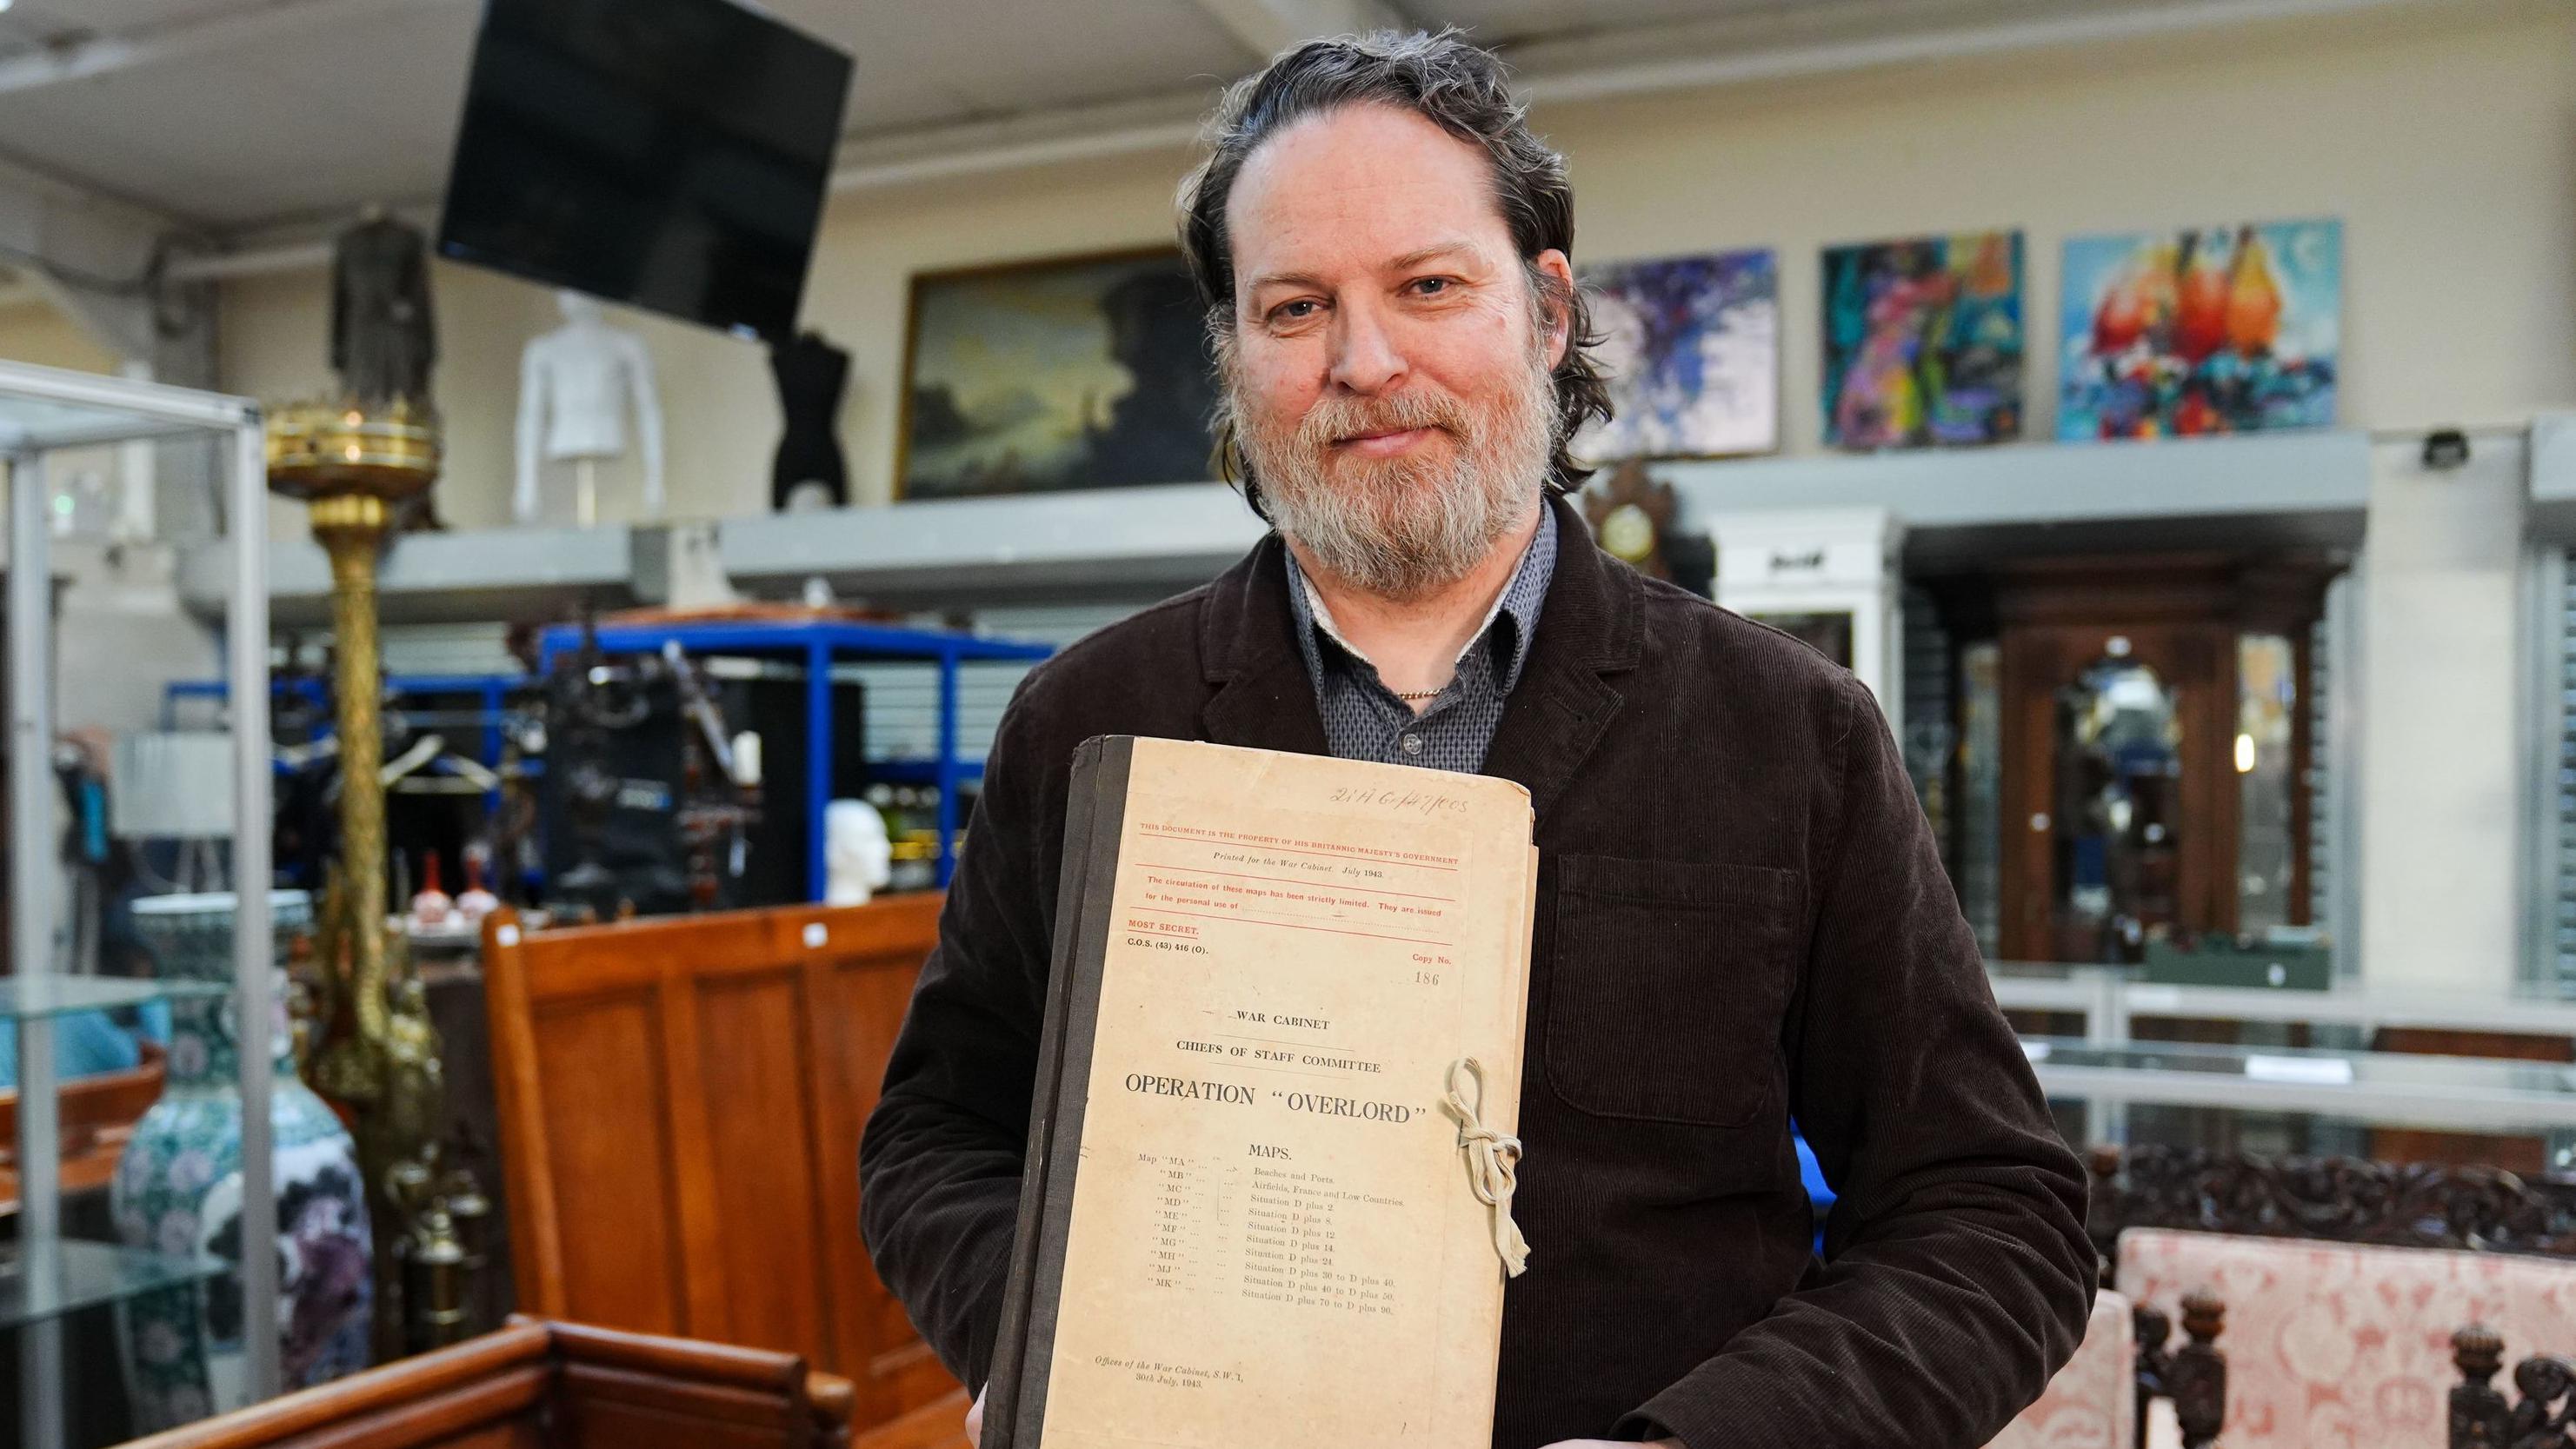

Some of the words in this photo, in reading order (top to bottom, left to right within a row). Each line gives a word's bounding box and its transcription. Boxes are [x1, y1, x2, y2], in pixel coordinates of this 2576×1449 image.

[1162, 826, 1206, 835] DOCUMENT
[1238, 834, 1280, 843] PROPERTY
[1311, 842, 1355, 853] BRITANNIC
[1358, 847, 1401, 858] MAJESTY'S
[1402, 853, 1459, 865] GOVERNMENT
[1214, 852, 1244, 861] Printed
[1342, 867, 1361, 877] July
[1166, 880, 1208, 889] circulation
[1223, 885, 1242, 894] these
[1246, 888, 1267, 897] maps
[1308, 895, 1336, 905] strictly
[1340, 898, 1369, 908] limited.
[1378, 902, 1398, 913] They
[1418, 907, 1441, 916] issued
[1177, 896, 1210, 907] personal
[1128, 920, 1155, 929] MOST
[1159, 923, 1199, 935] SECRET.
[1128, 938, 1153, 947] C.O.S.
[1155, 941, 1172, 951] (43)
[1413, 953, 1433, 963] Copy
[1438, 956, 1452, 965] No.
[1415, 971, 1440, 986] 186
[1235, 1009, 1266, 1023] WAR
[1273, 1014, 1330, 1030] CABINET
[1176, 1040, 1222, 1054] CHIEFS
[1229, 1047, 1248, 1057] OF
[1254, 1049, 1295, 1063] STAFF
[1301, 1055, 1381, 1073] COMMITTEE
[1124, 1073, 1255, 1106] OPERATION
[1270, 1091, 1427, 1124] “OVERLORD”
[1248, 1144, 1292, 1160] MAPS.
[1138, 1153, 1157, 1164] Map
[1162, 1156, 1194, 1166] “MA”
[1254, 1167, 1287, 1178] Beaches
[1159, 1183, 1190, 1193] “MC”
[1250, 1194, 1289, 1206] Situation
[1306, 1201, 1323, 1211] plus
[1252, 1181, 1290, 1193] Airfields,
[1294, 1186, 1321, 1196] France
[1342, 1192, 1360, 1201] Low
[1157, 1197, 1188, 1206] “MD”
[1248, 1208, 1287, 1220] Situation
[1304, 1214, 1321, 1224] plus
[1248, 1222, 1286, 1233] Situation
[1303, 1229, 1321, 1238] plus
[1246, 1234, 1285, 1246] Situation
[1301, 1241, 1320, 1251] plus
[1245, 1248, 1284, 1260] Situation
[1301, 1255, 1318, 1264] plus
[1245, 1262, 1284, 1273] Situation
[1301, 1268, 1318, 1278] plus
[1361, 1276, 1379, 1286] plus
[1243, 1275, 1283, 1287] Situation
[1300, 1283, 1317, 1292] plus
[1361, 1290, 1378, 1299] plus
[1241, 1289, 1281, 1301] Situation
[1298, 1296, 1315, 1306] plus
[1359, 1303, 1376, 1313] plus
[1095, 1355, 1122, 1366] Offices
[1125, 1359, 1134, 1369] of
[1136, 1360, 1150, 1369] the
[1154, 1363, 1173, 1373] War
[1175, 1366, 1210, 1379] Cabinet,
[1157, 1376, 1178, 1386] July,
